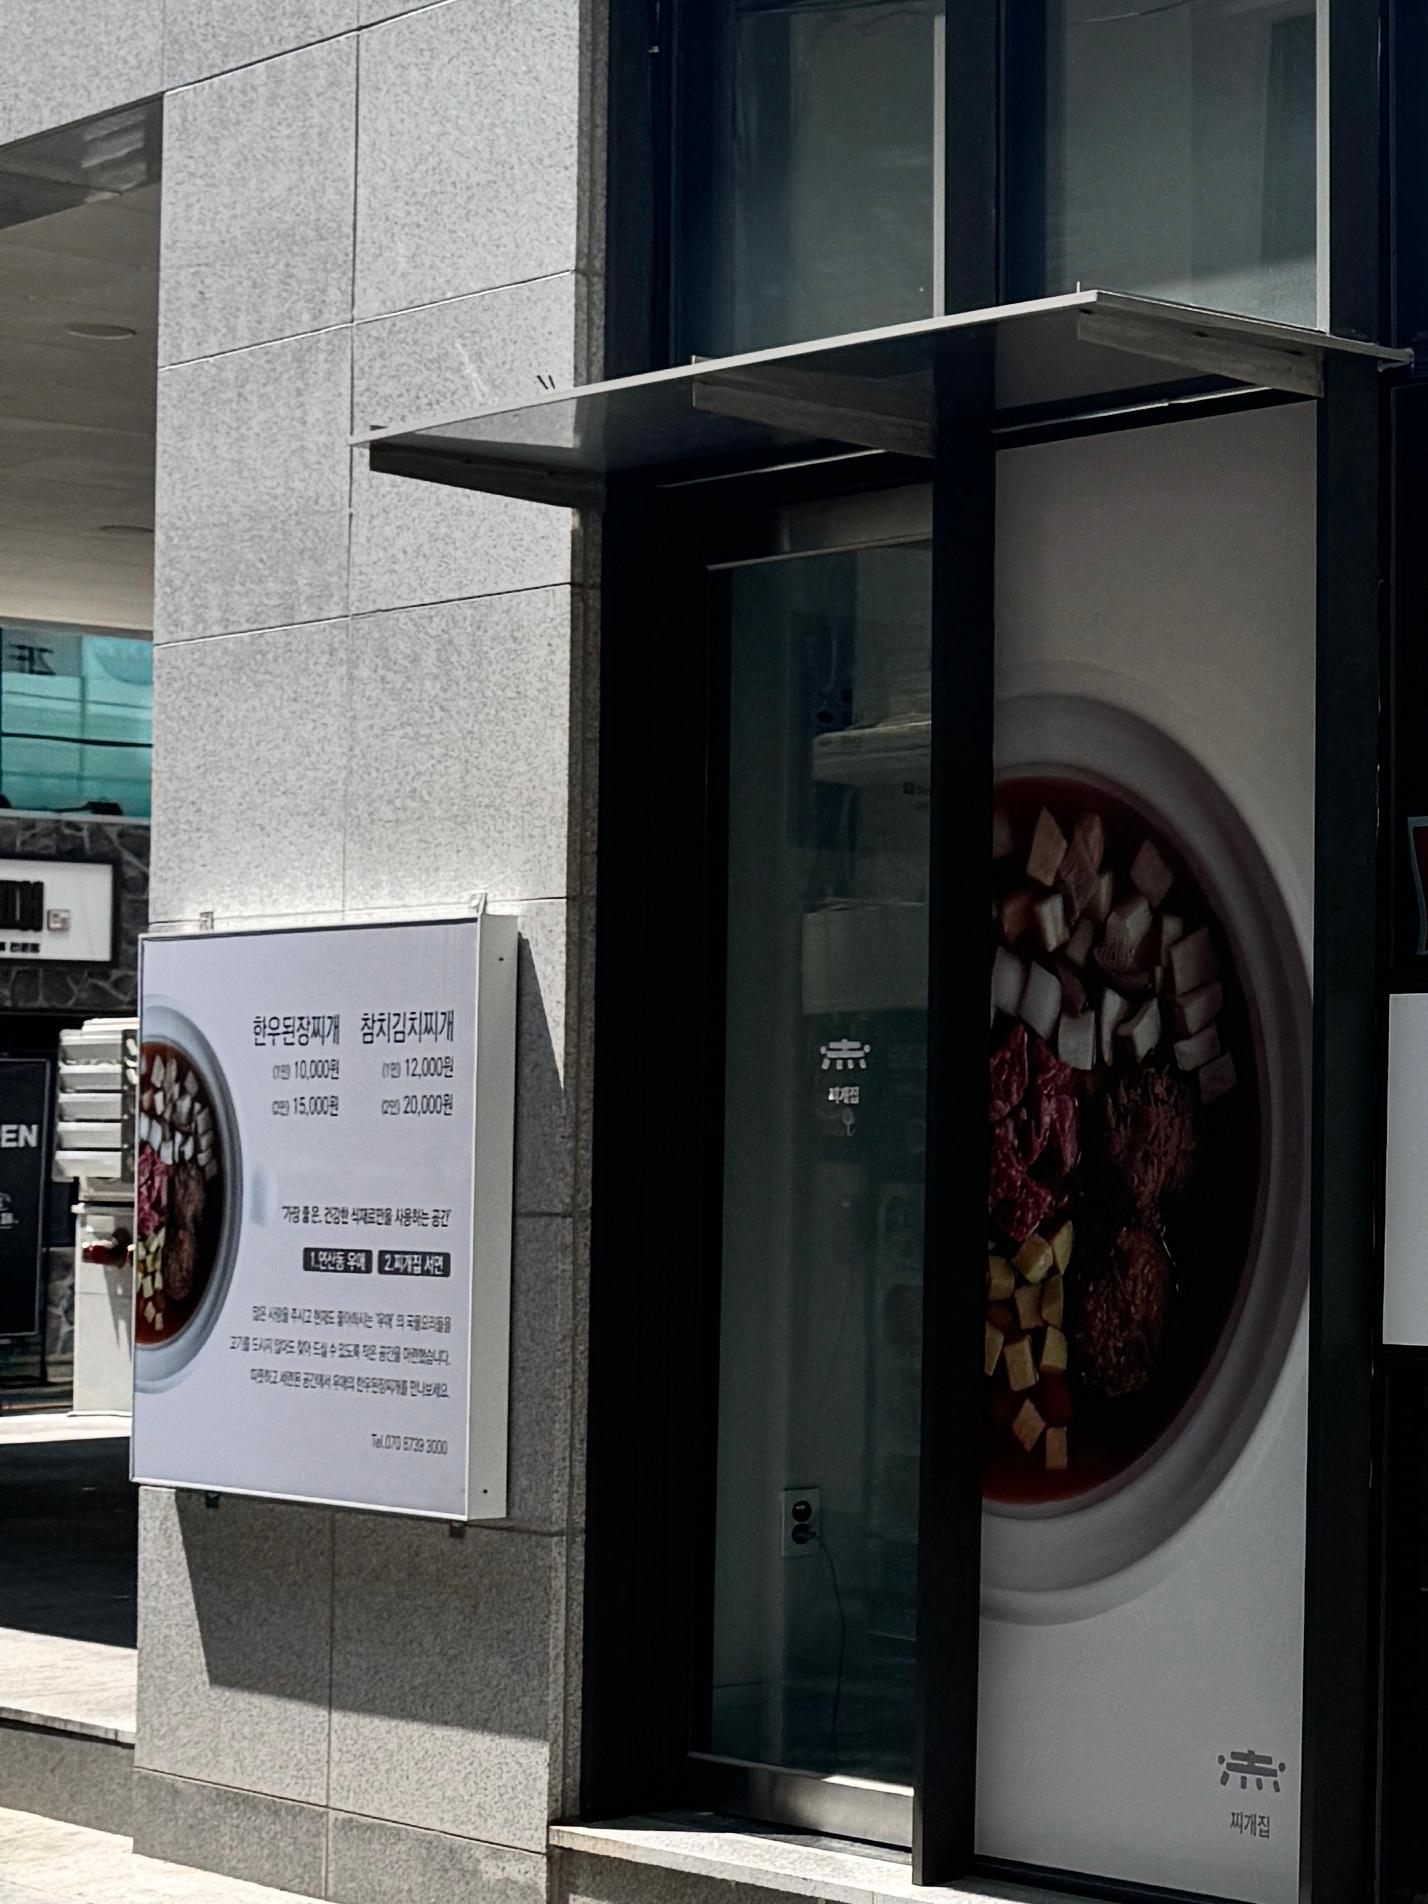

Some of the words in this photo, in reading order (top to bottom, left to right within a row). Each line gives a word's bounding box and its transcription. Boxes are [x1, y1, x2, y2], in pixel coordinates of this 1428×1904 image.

[253, 1014, 340, 1046] 한우된장찌개
[361, 1010, 454, 1044] 참치김치찌개
[294, 1059, 340, 1080] 10,000원
[405, 1056, 454, 1078] 12,000원
[293, 1095, 339, 1117] 15,000원
[403, 1093, 453, 1116] 20,000원
[1230, 1812, 1270, 1838] 찌개집
